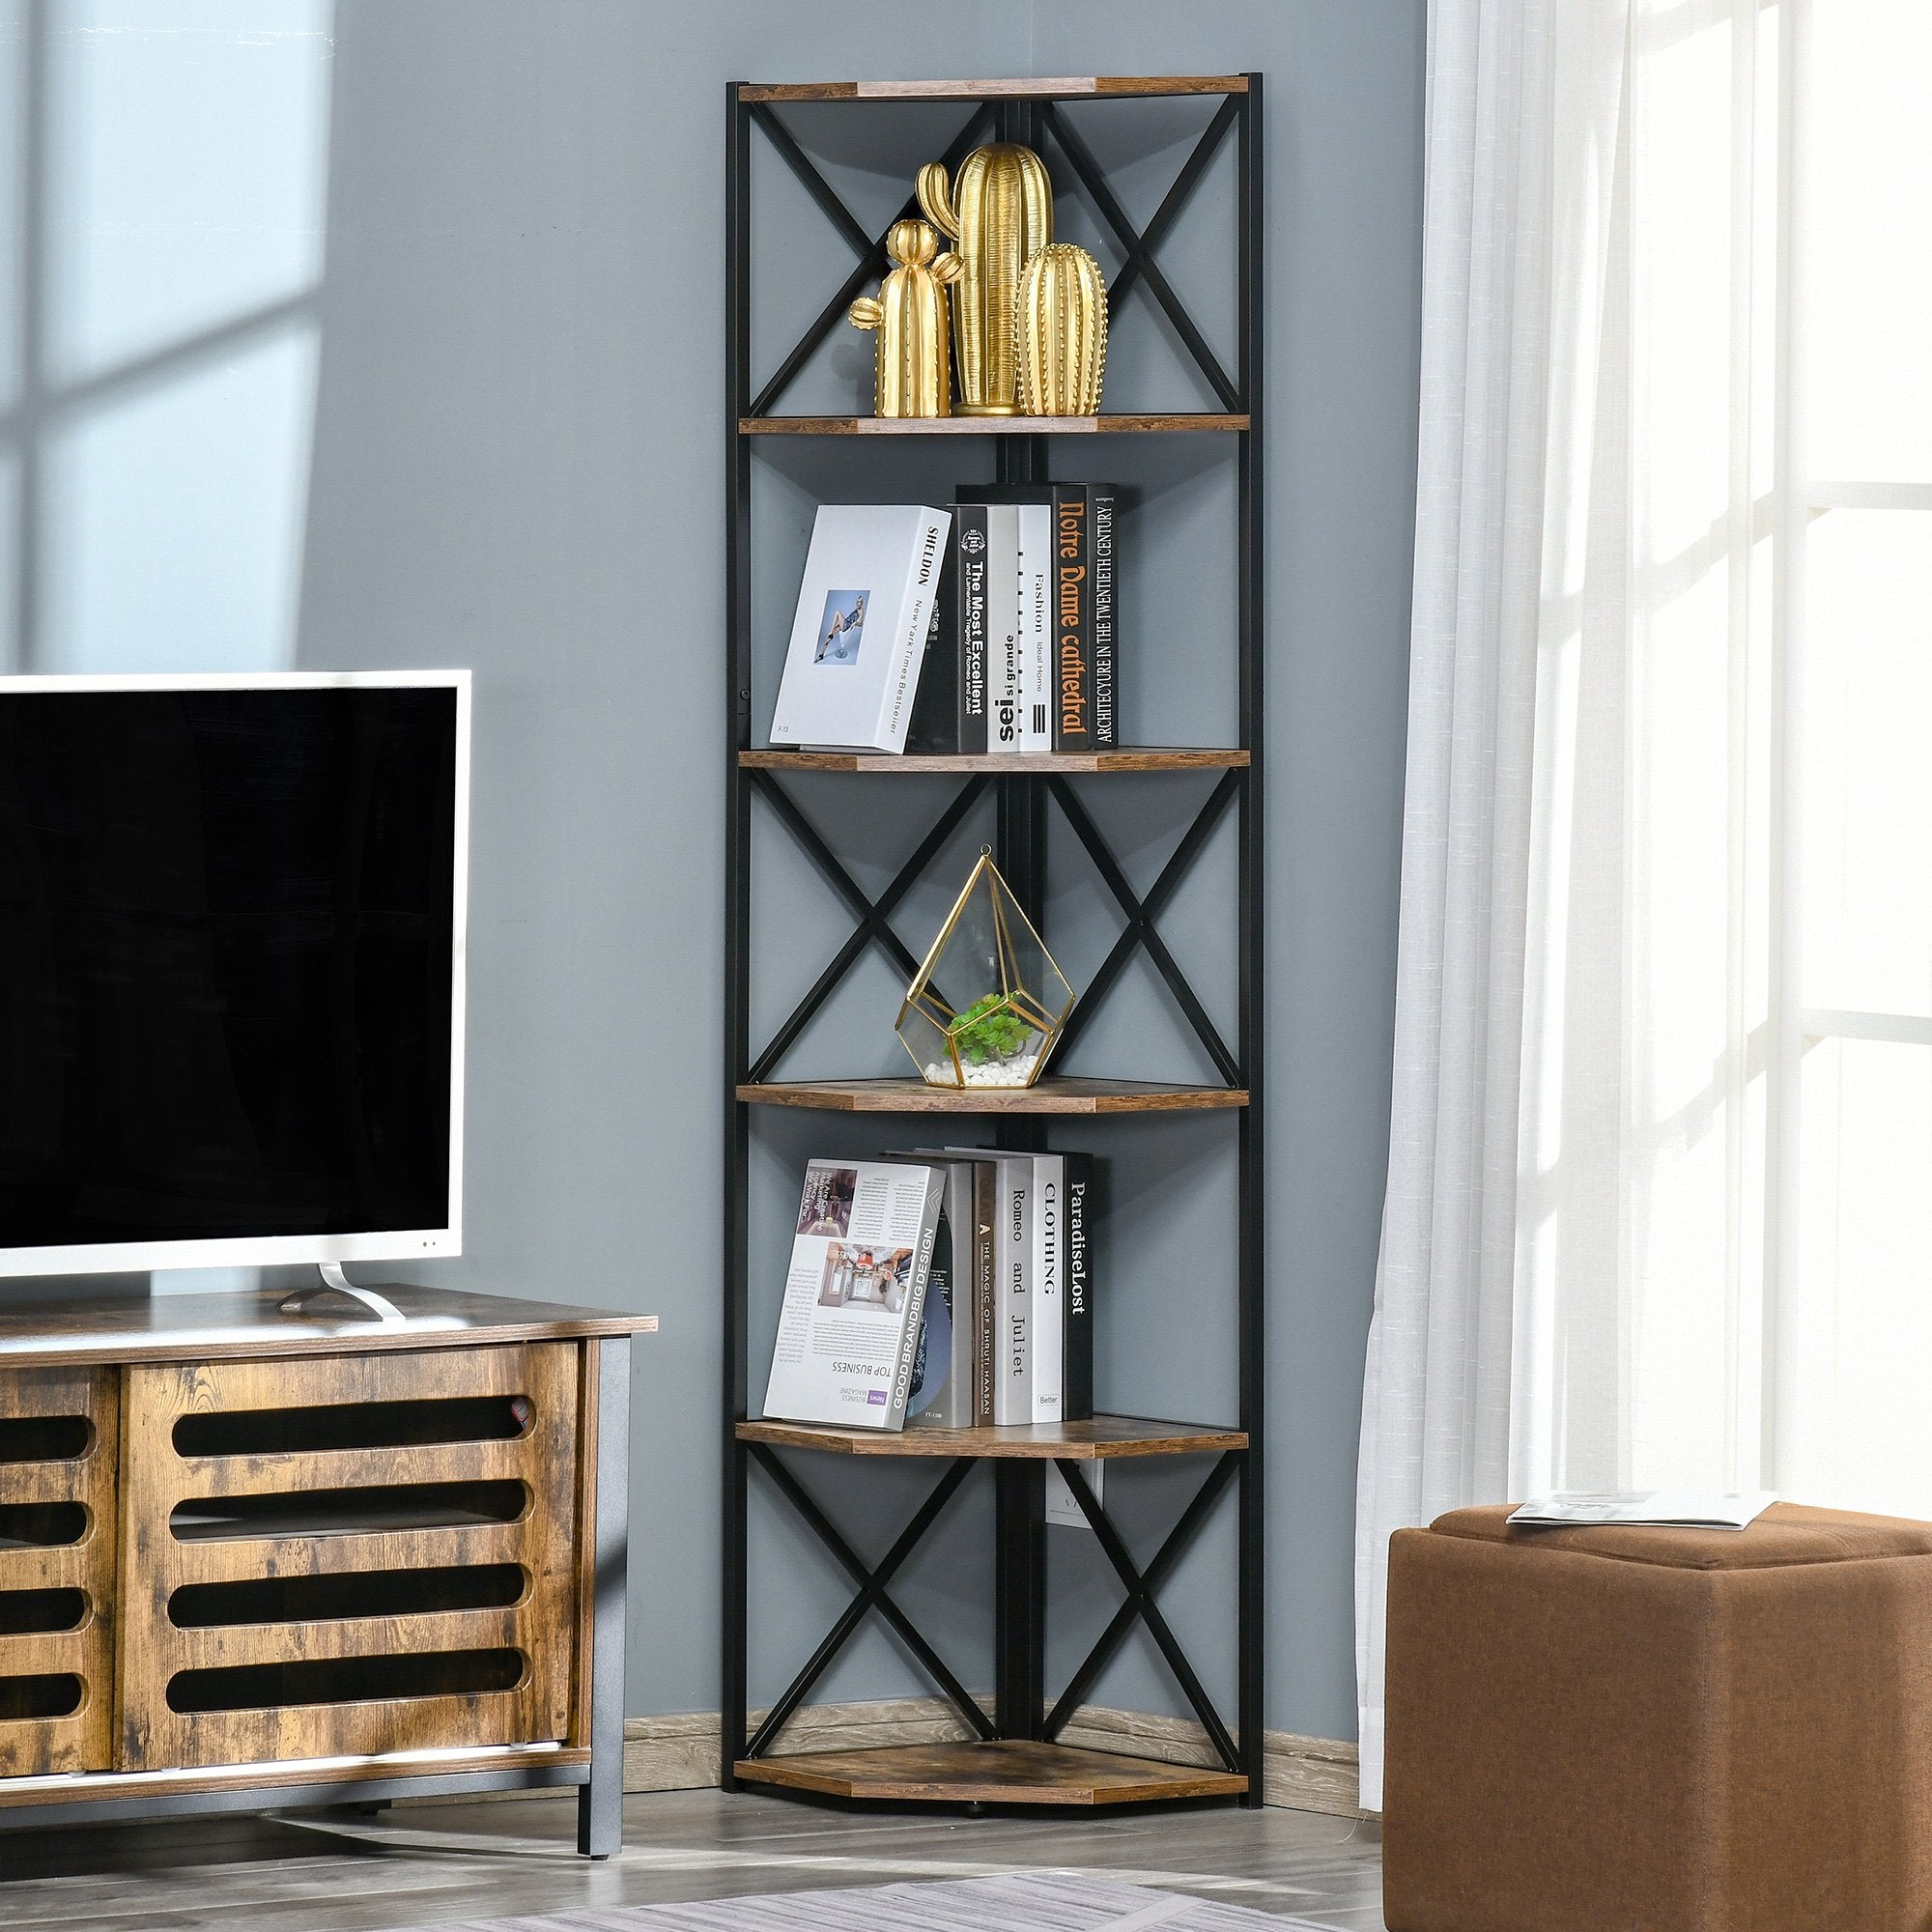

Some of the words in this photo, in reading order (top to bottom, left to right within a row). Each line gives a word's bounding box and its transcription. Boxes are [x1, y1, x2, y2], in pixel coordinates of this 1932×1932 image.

[1059, 501, 1084, 558] Notre
[1096, 506, 1112, 556] CENTURY
[918, 526, 939, 587] SHELDON
[972, 560, 983, 592] The
[912, 599, 923, 622] New
[1036, 574, 1044, 633] Fashion
[1060, 565, 1086, 627] Dame
[1096, 558, 1112, 621] TWENTIETH
[972, 596, 983, 637] Most
[1096, 621, 1112, 644] THE
[900, 649, 914, 680] Times
[1005, 635, 1016, 681] grande
[1096, 645, 1112, 658] IN
[972, 639, 983, 715] Excellent
[1005, 684, 1013, 696] si
[1061, 635, 1088, 734] cathedral
[994, 699, 1014, 742] sei
[1096, 659, 1112, 743] ARCHITECYURE
[979, 1223, 991, 1236] A
[1012, 1189, 1025, 1242] Romeo
[1044, 1182, 1056, 1295] CLOTHING
[1071, 1181, 1087, 1315] ParadiseLost
[1012, 1263, 1026, 1294] and
[894, 1364, 909, 1409] GOOD
[916, 1227, 934, 1285] DESIGN
[983, 1308, 990, 1324] OF
[1011, 1315, 1025, 1378] Juliet
[833, 1361, 873, 1376] BUSINESS
[873, 1367, 892, 1378] TOP
[841, 1394, 867, 1404] BUSINESS
[869, 1394, 885, 1404] News
[1039, 1396, 1058, 1405] Better
